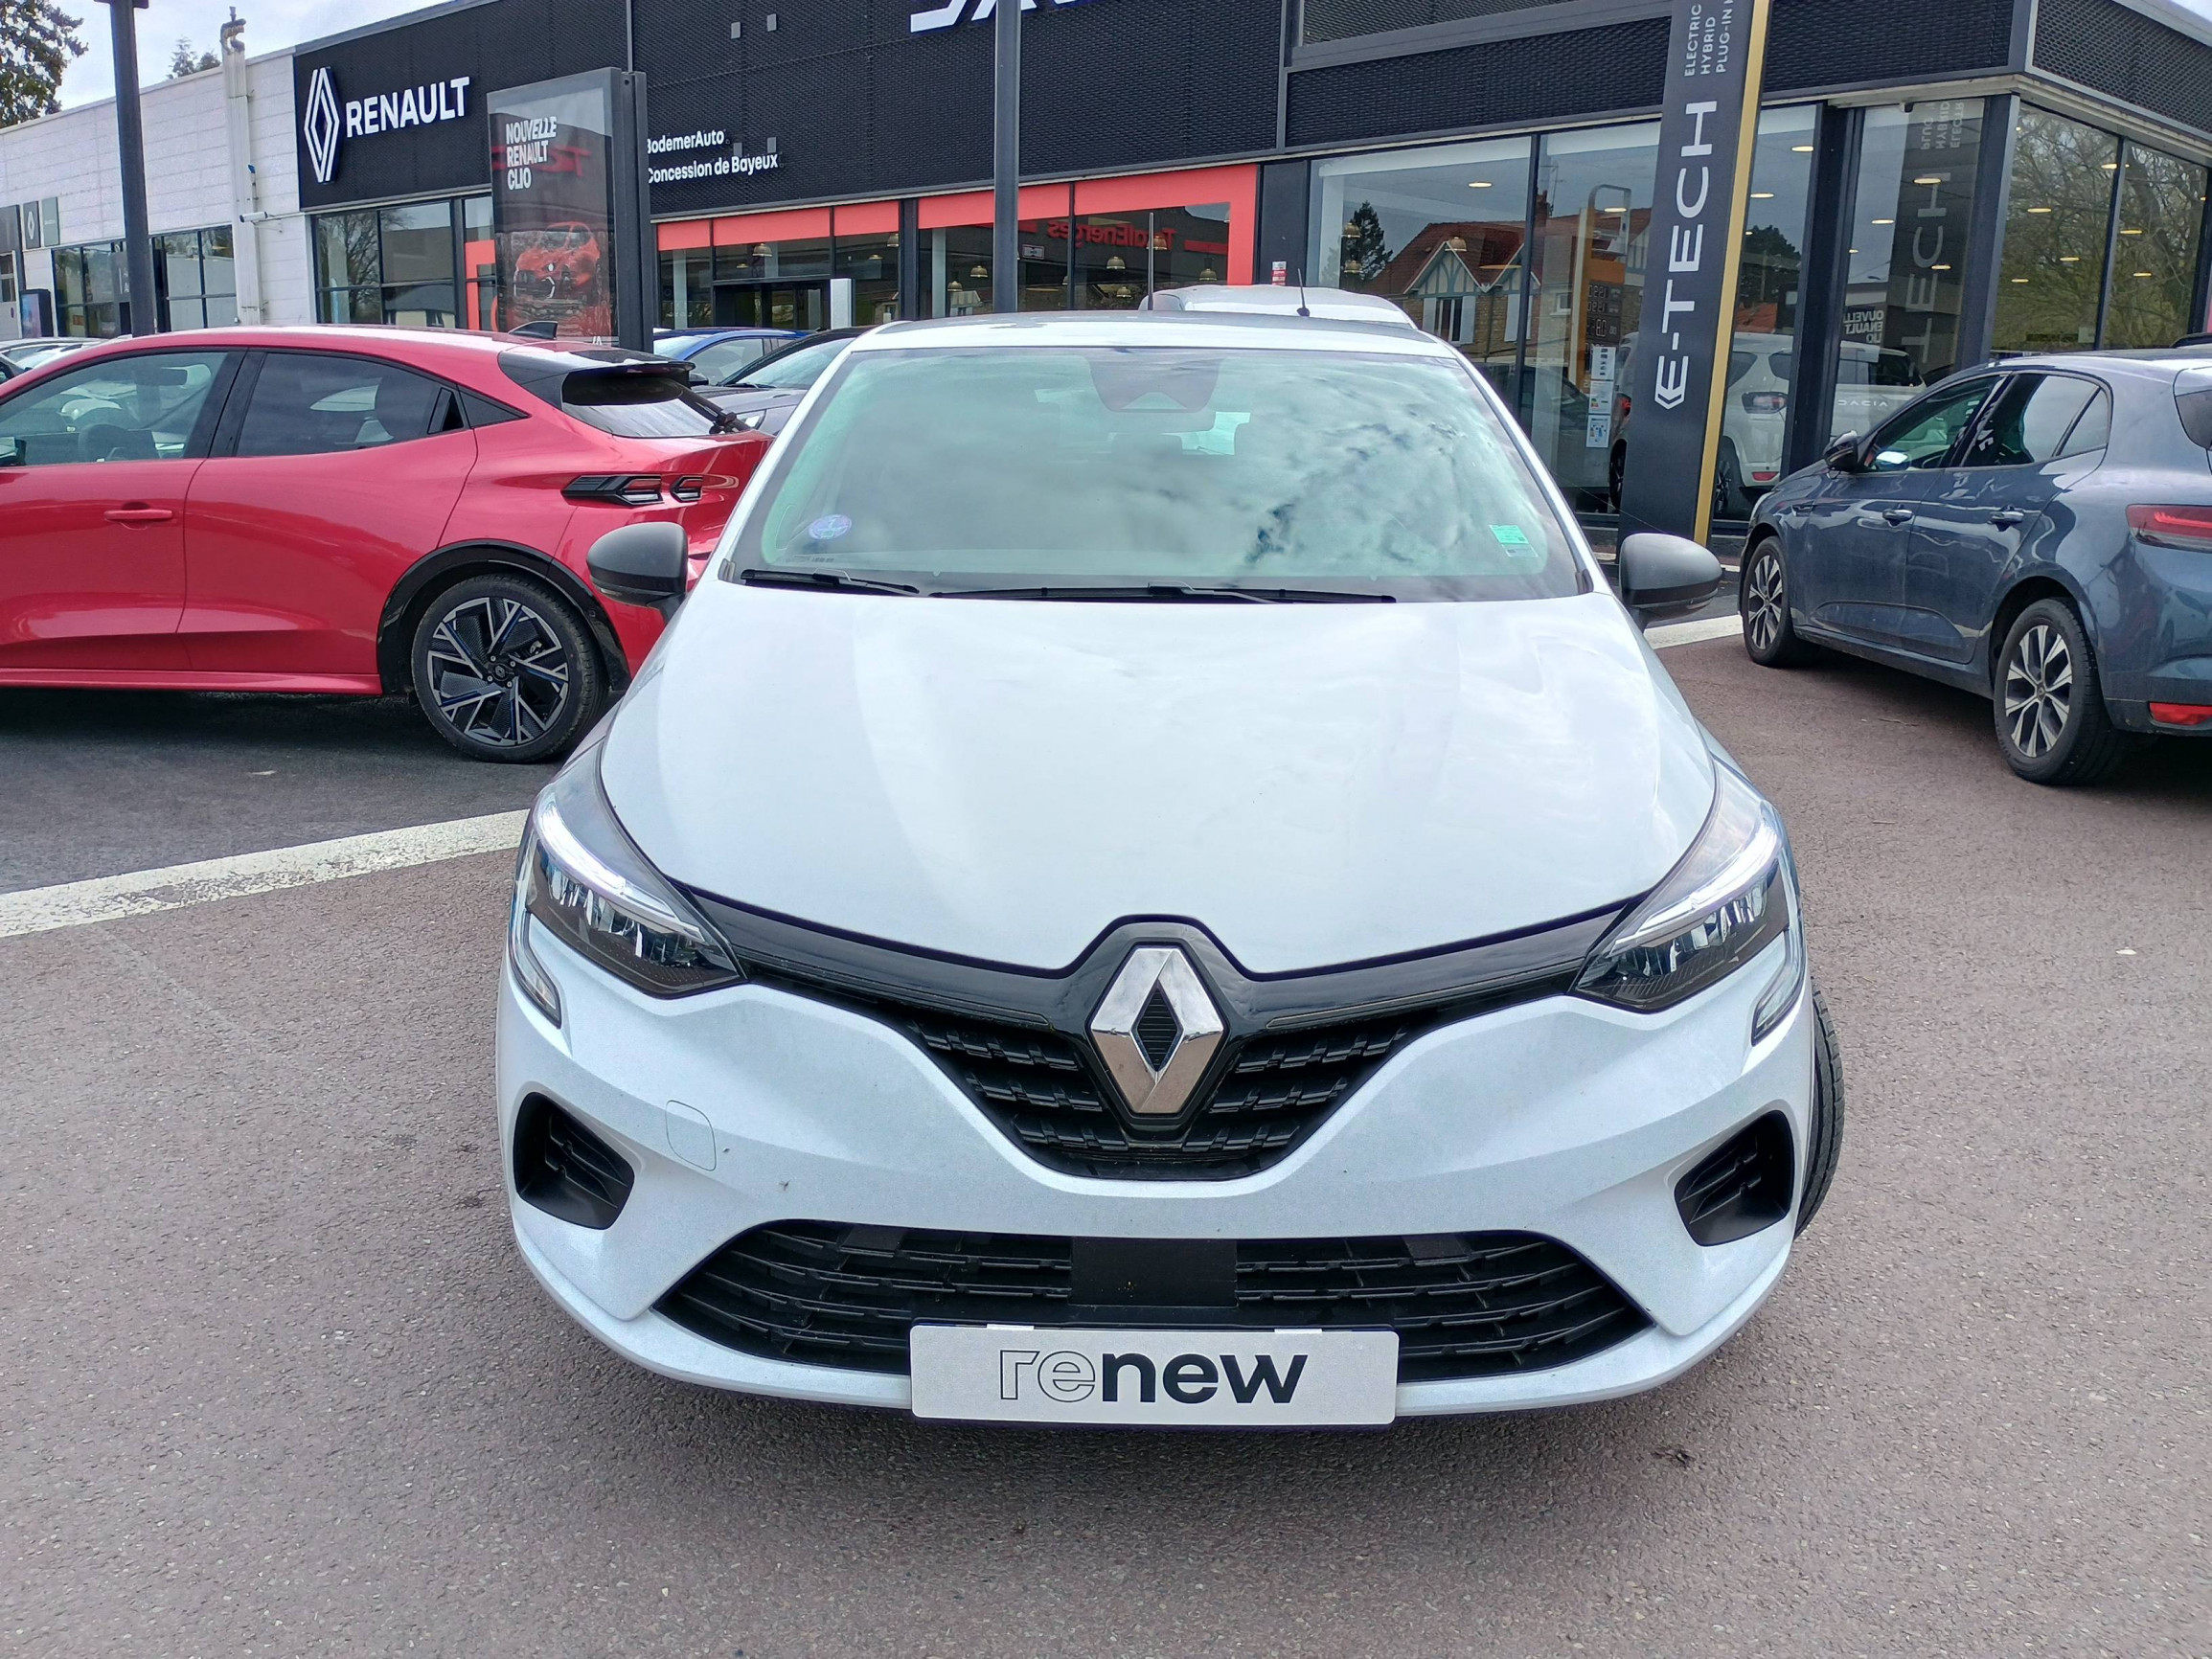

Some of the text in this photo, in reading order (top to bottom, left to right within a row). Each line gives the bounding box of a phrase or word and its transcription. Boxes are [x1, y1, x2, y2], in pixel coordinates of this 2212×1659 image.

[1684, 4, 1702, 77] ELECTRIC
[1700, 16, 1716, 75] HYBRID
[1716, 9, 1733, 73] PLUG-IN
[346, 76, 470, 138] RENAULT
[506, 116, 558, 145] NOUVELLE
[507, 140, 549, 168] RENAULT
[508, 168, 532, 191] CLIO
[714, 157, 730, 175] de
[731, 153, 779, 175] Bayeux
[1654, 101, 1718, 410] E-TECH
[999, 1349, 1309, 1404] renew
